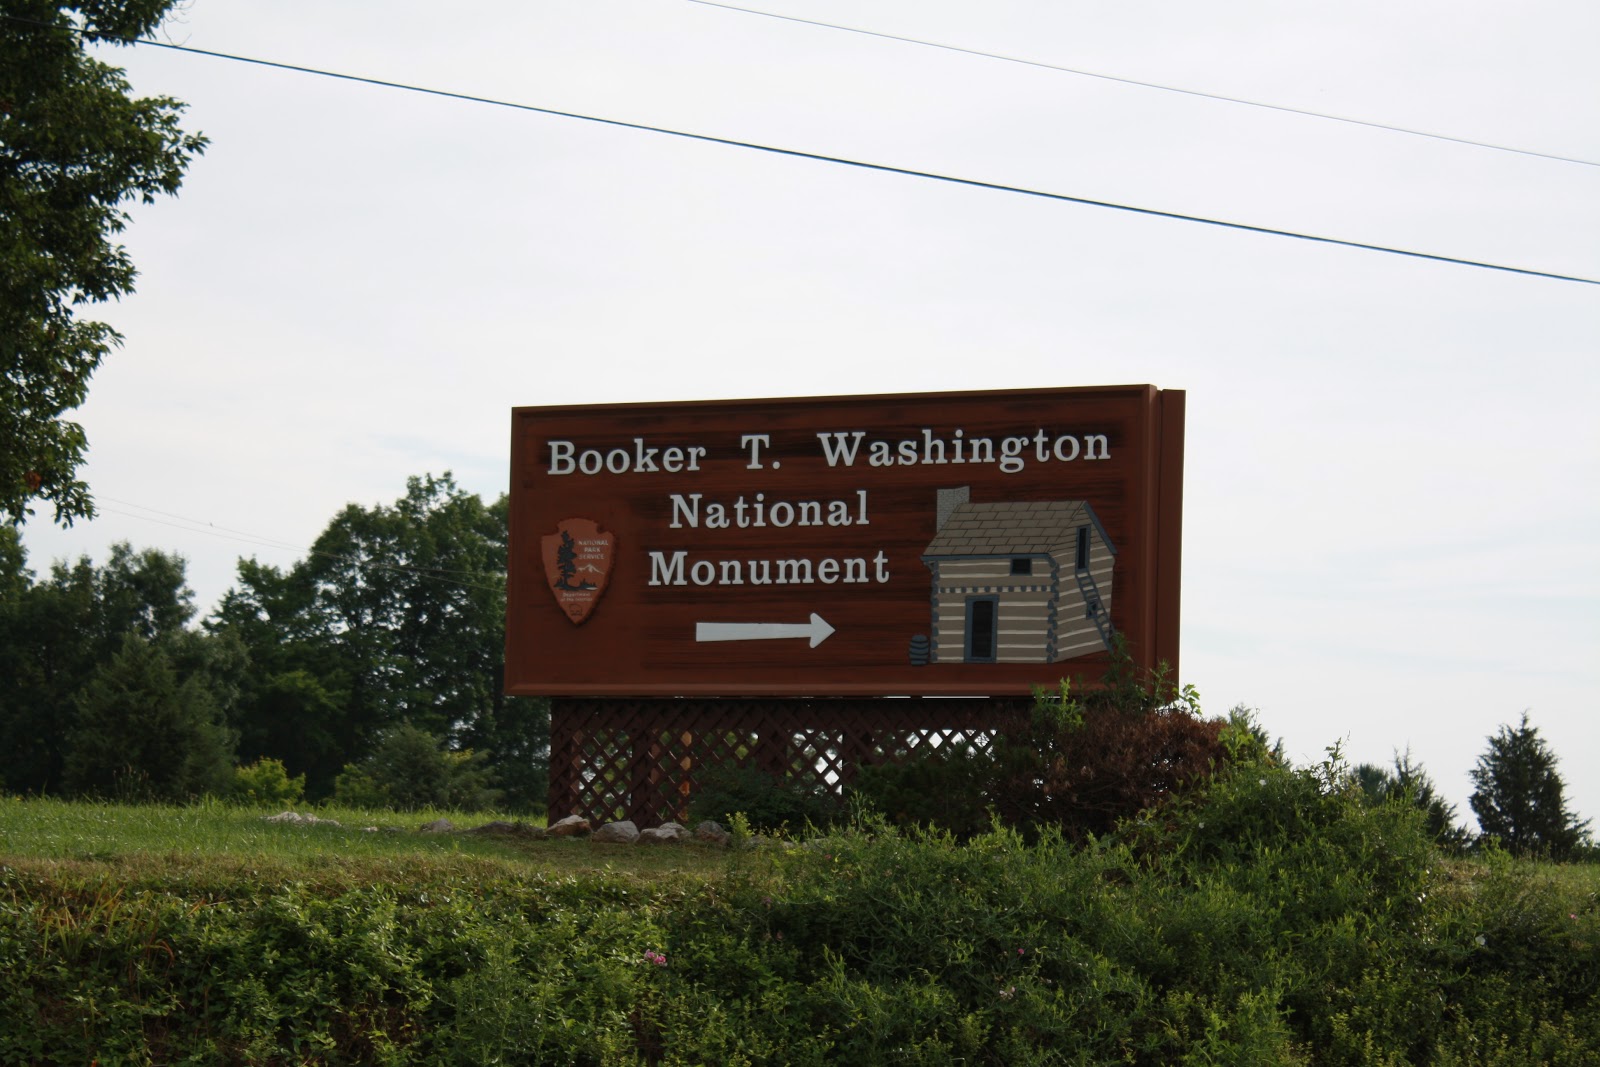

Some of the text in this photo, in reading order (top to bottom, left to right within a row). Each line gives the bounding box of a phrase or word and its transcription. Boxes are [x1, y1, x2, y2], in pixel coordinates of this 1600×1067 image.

[546, 427, 1112, 476] Booker T. Washington
[668, 489, 870, 530] National
[647, 549, 891, 587] Monument
